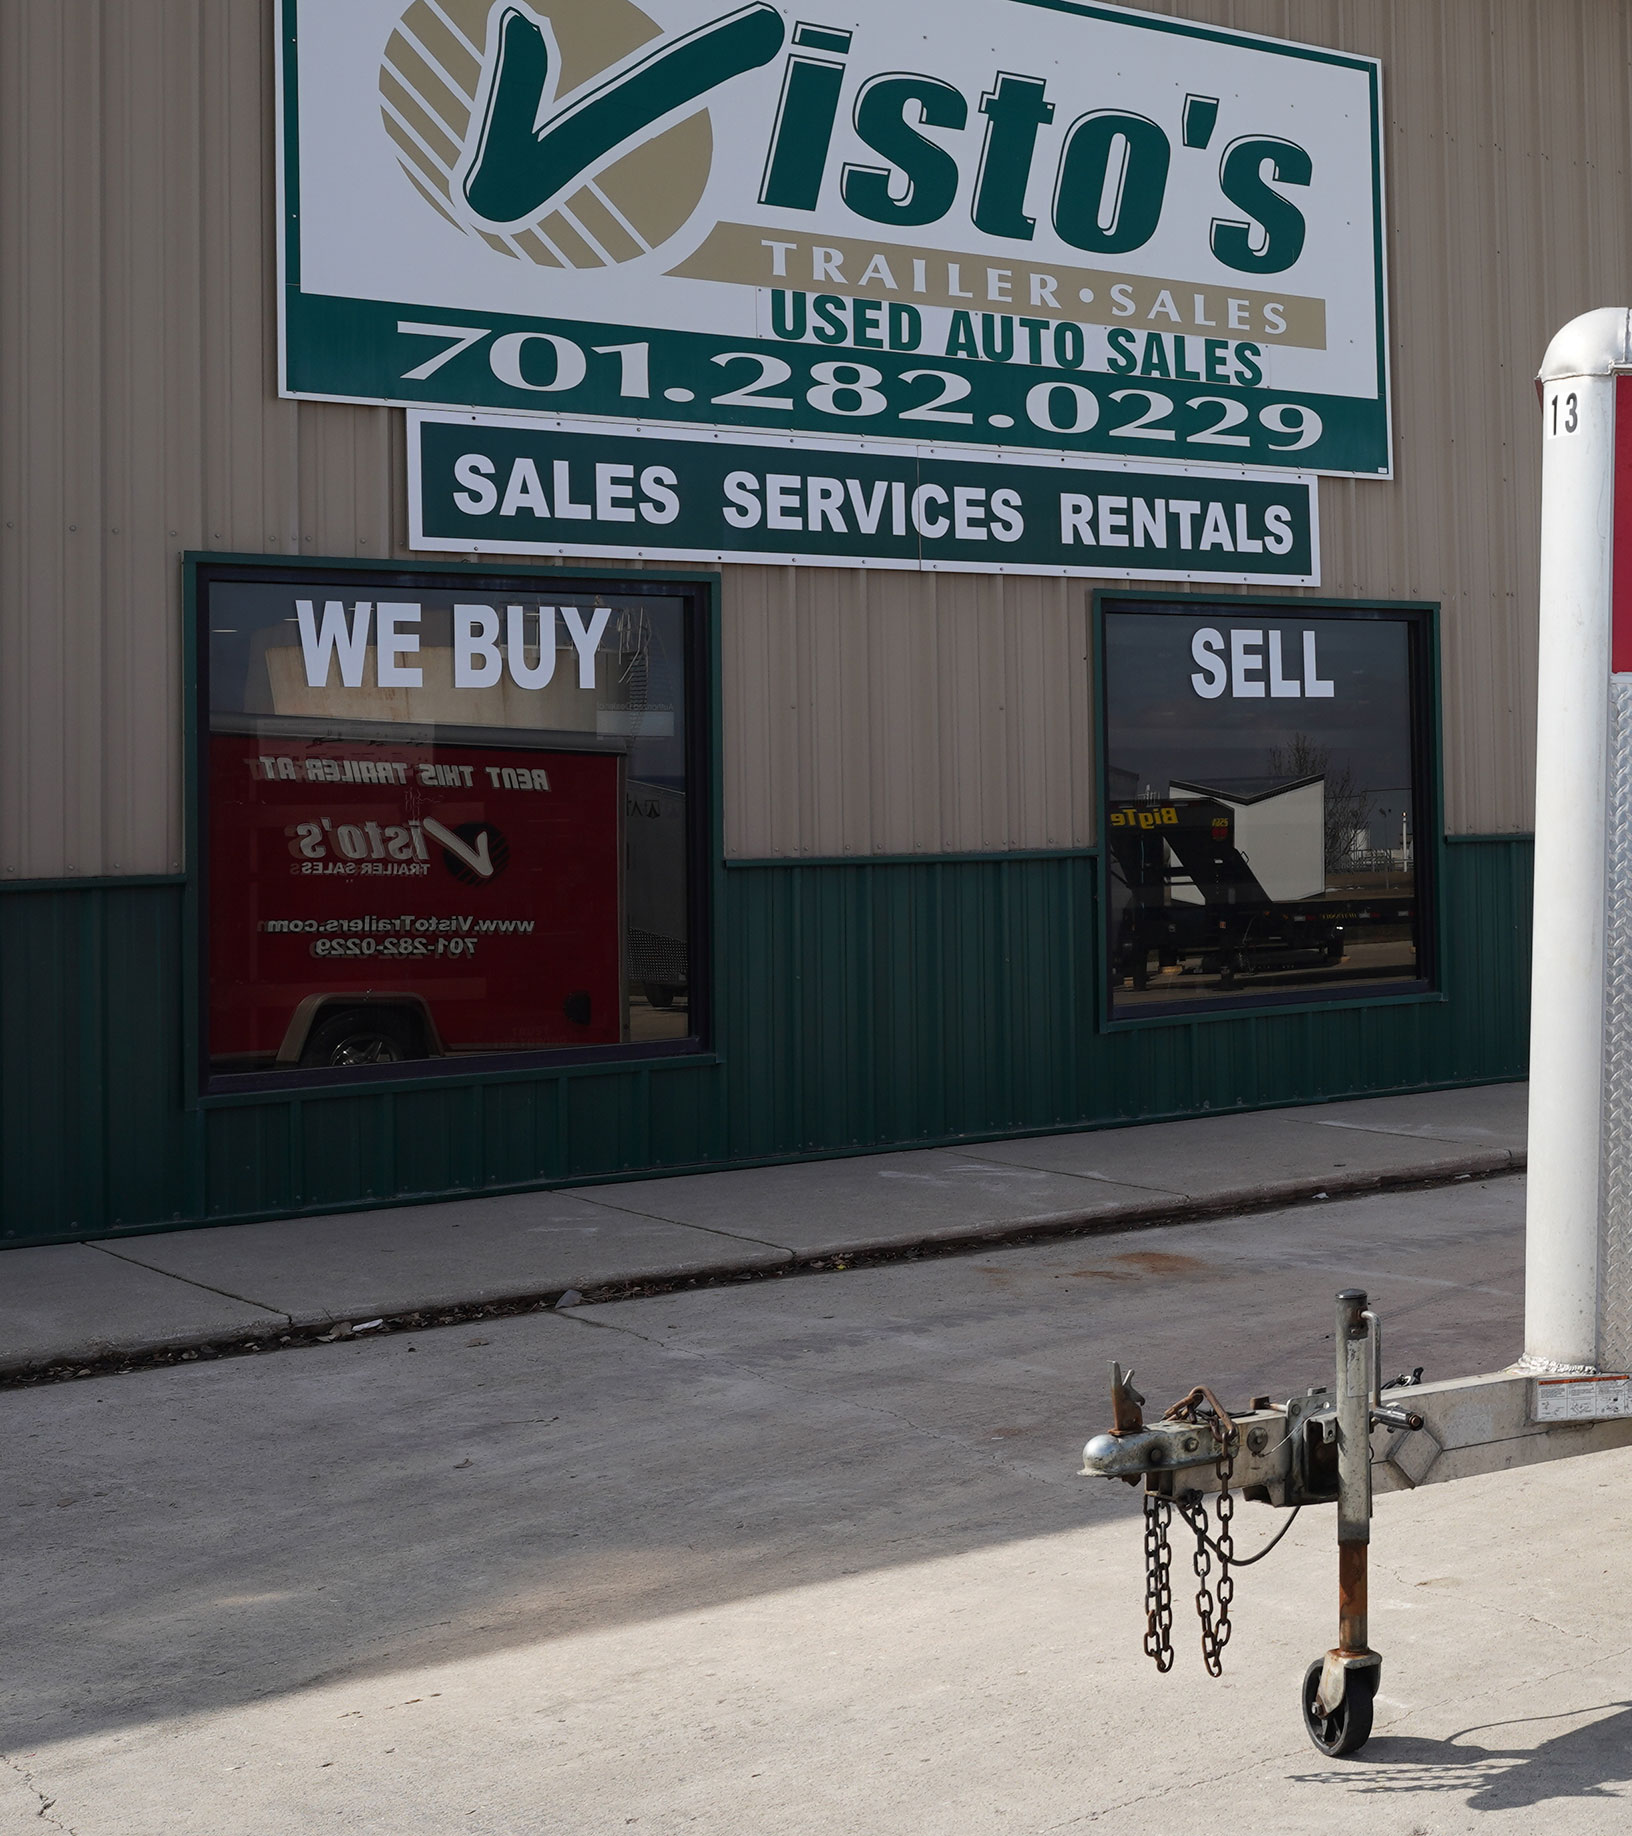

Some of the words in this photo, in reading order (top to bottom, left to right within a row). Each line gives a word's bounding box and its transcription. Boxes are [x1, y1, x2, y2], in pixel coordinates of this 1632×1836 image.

[462, 1, 1314, 275] Visto's
[760, 239, 1062, 310] TRAILER
[1110, 283, 1288, 336] SALES
[396, 320, 1324, 452] 701.282.0229
[771, 288, 923, 353] USED
[945, 308, 1085, 370] AUTO
[1106, 327, 1263, 389] SALES
[453, 454, 680, 527] SALES
[722, 468, 1026, 542] SERVICES
[1060, 492, 1294, 556] RENTALS
[295, 600, 424, 688] WE
[453, 603, 612, 690] BUY
[1190, 627, 1335, 700] SELL
